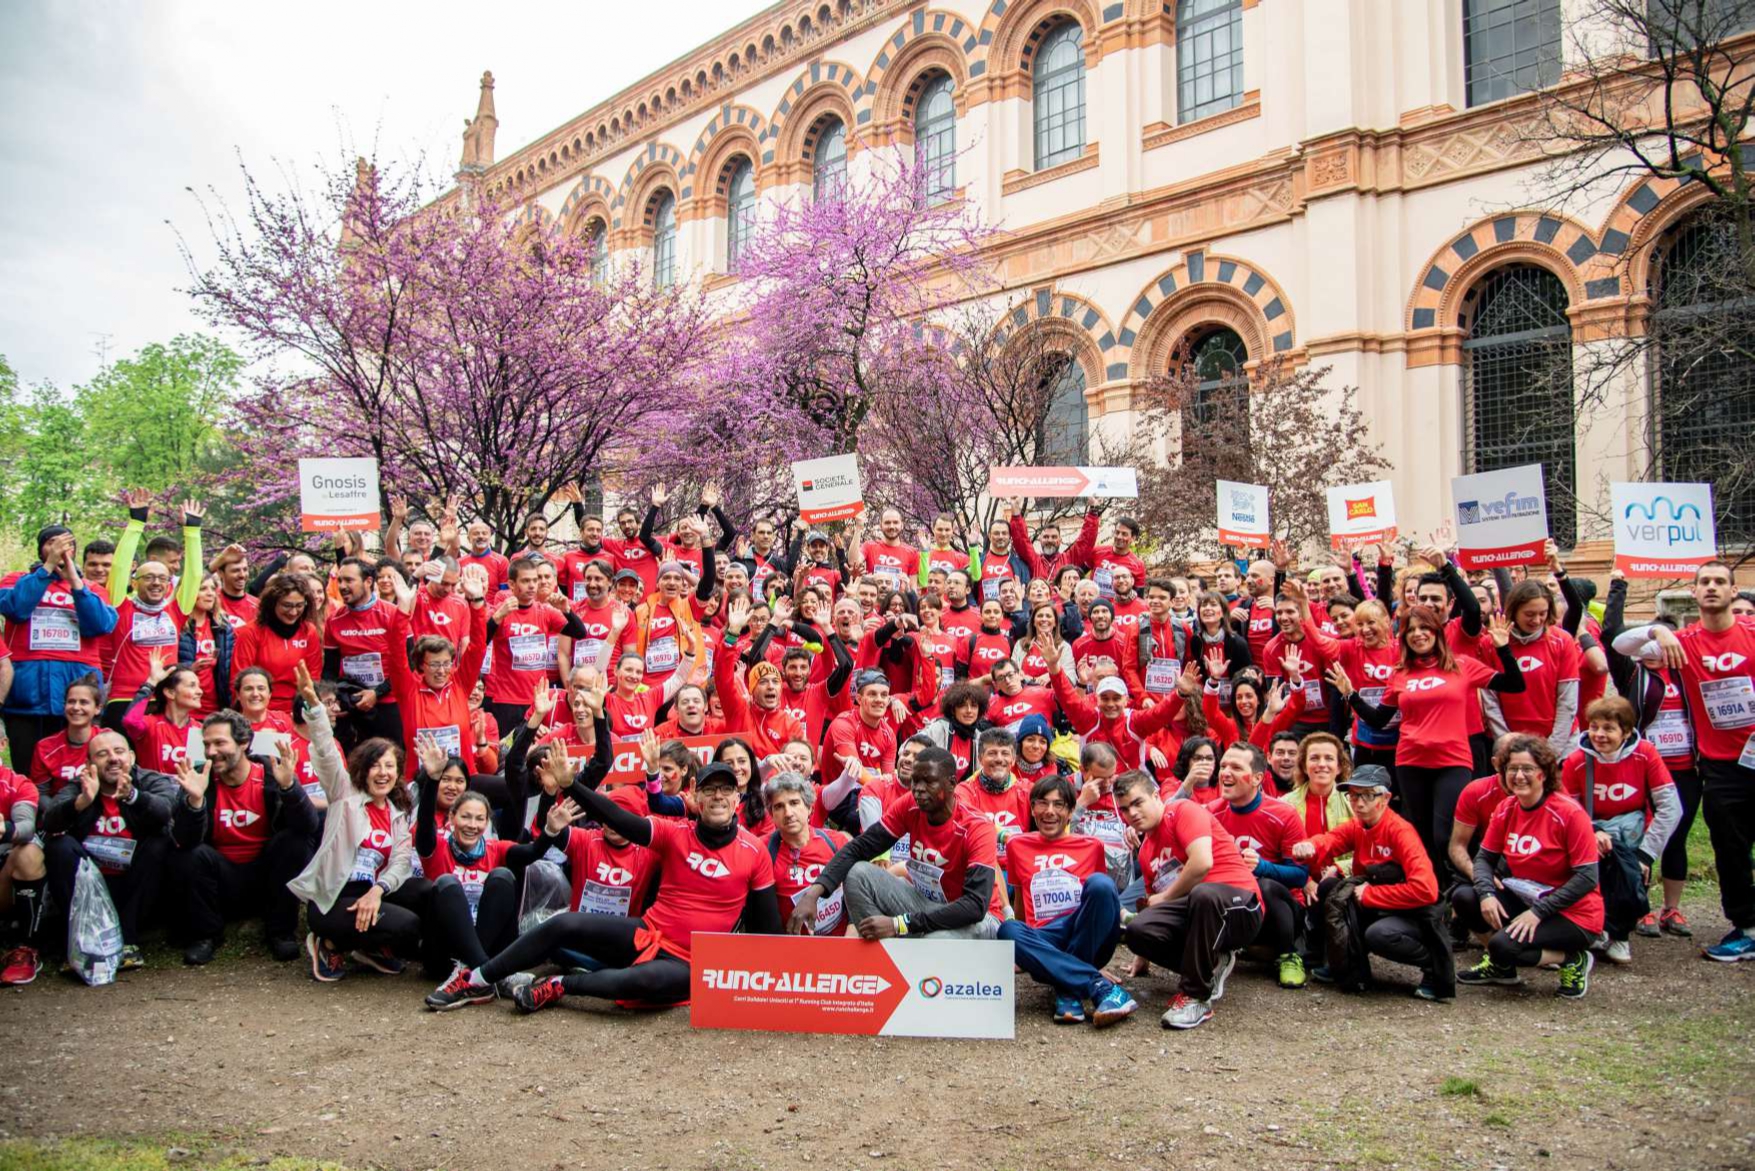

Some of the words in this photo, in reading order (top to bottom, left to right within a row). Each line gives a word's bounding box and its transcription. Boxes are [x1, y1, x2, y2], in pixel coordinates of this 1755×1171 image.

[312, 474, 366, 490] Gnosis
[816, 479, 854, 490] GENERALE
[329, 490, 367, 498] Lesaffre
[1480, 492, 1539, 516] vefim
[1626, 520, 1702, 546] verpul
[42, 628, 70, 638] 1678D
[1702, 652, 1732, 672] RC
[1406, 676, 1433, 692] RC
[1716, 704, 1746, 716] 1691A
[1658, 733, 1684, 744] 1691D
[1593, 782, 1625, 801] RC
[219, 808, 248, 828] RC
[1506, 832, 1532, 856] RC
[686, 852, 720, 878] RC
[1034, 854, 1065, 871] RC
[596, 862, 622, 886] RC
[1042, 891, 1072, 904] 1700A
[702, 969, 878, 995] RUNCHALLENGE
[944, 980, 1002, 996] azalea
